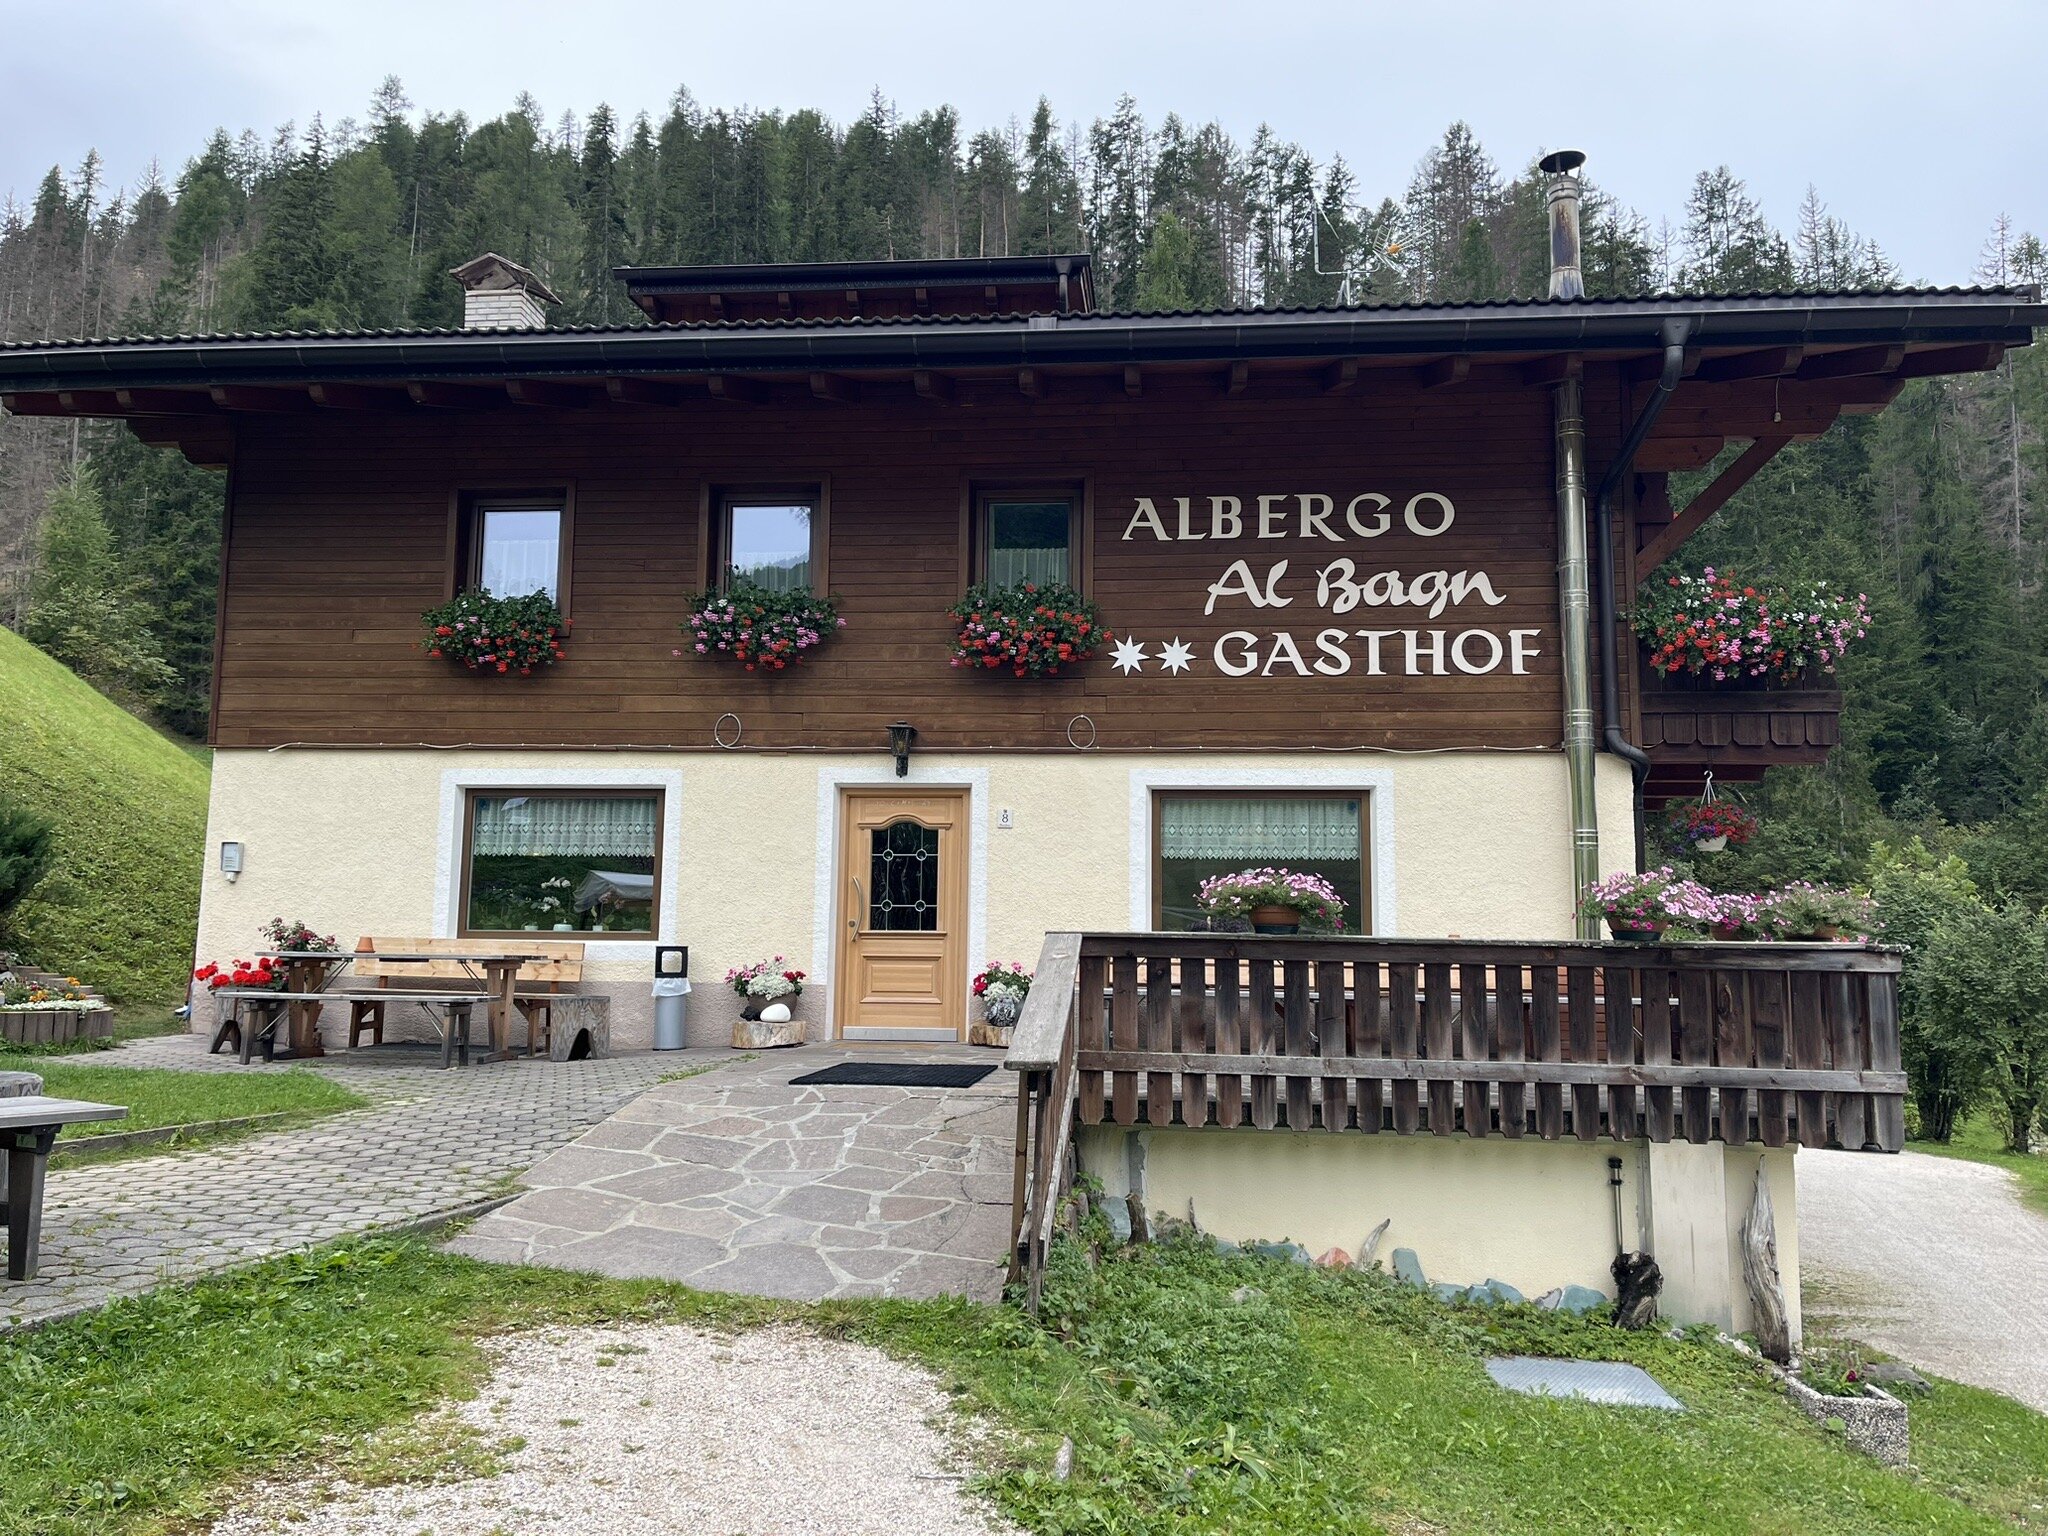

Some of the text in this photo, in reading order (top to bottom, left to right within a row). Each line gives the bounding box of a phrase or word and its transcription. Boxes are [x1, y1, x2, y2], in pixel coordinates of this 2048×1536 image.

[1122, 493, 1454, 541] ALBERGO
[1205, 558, 1506, 619] Al Bagn
[1214, 629, 1541, 676] GASTHOF
[1002, 813, 1009, 823] 8
